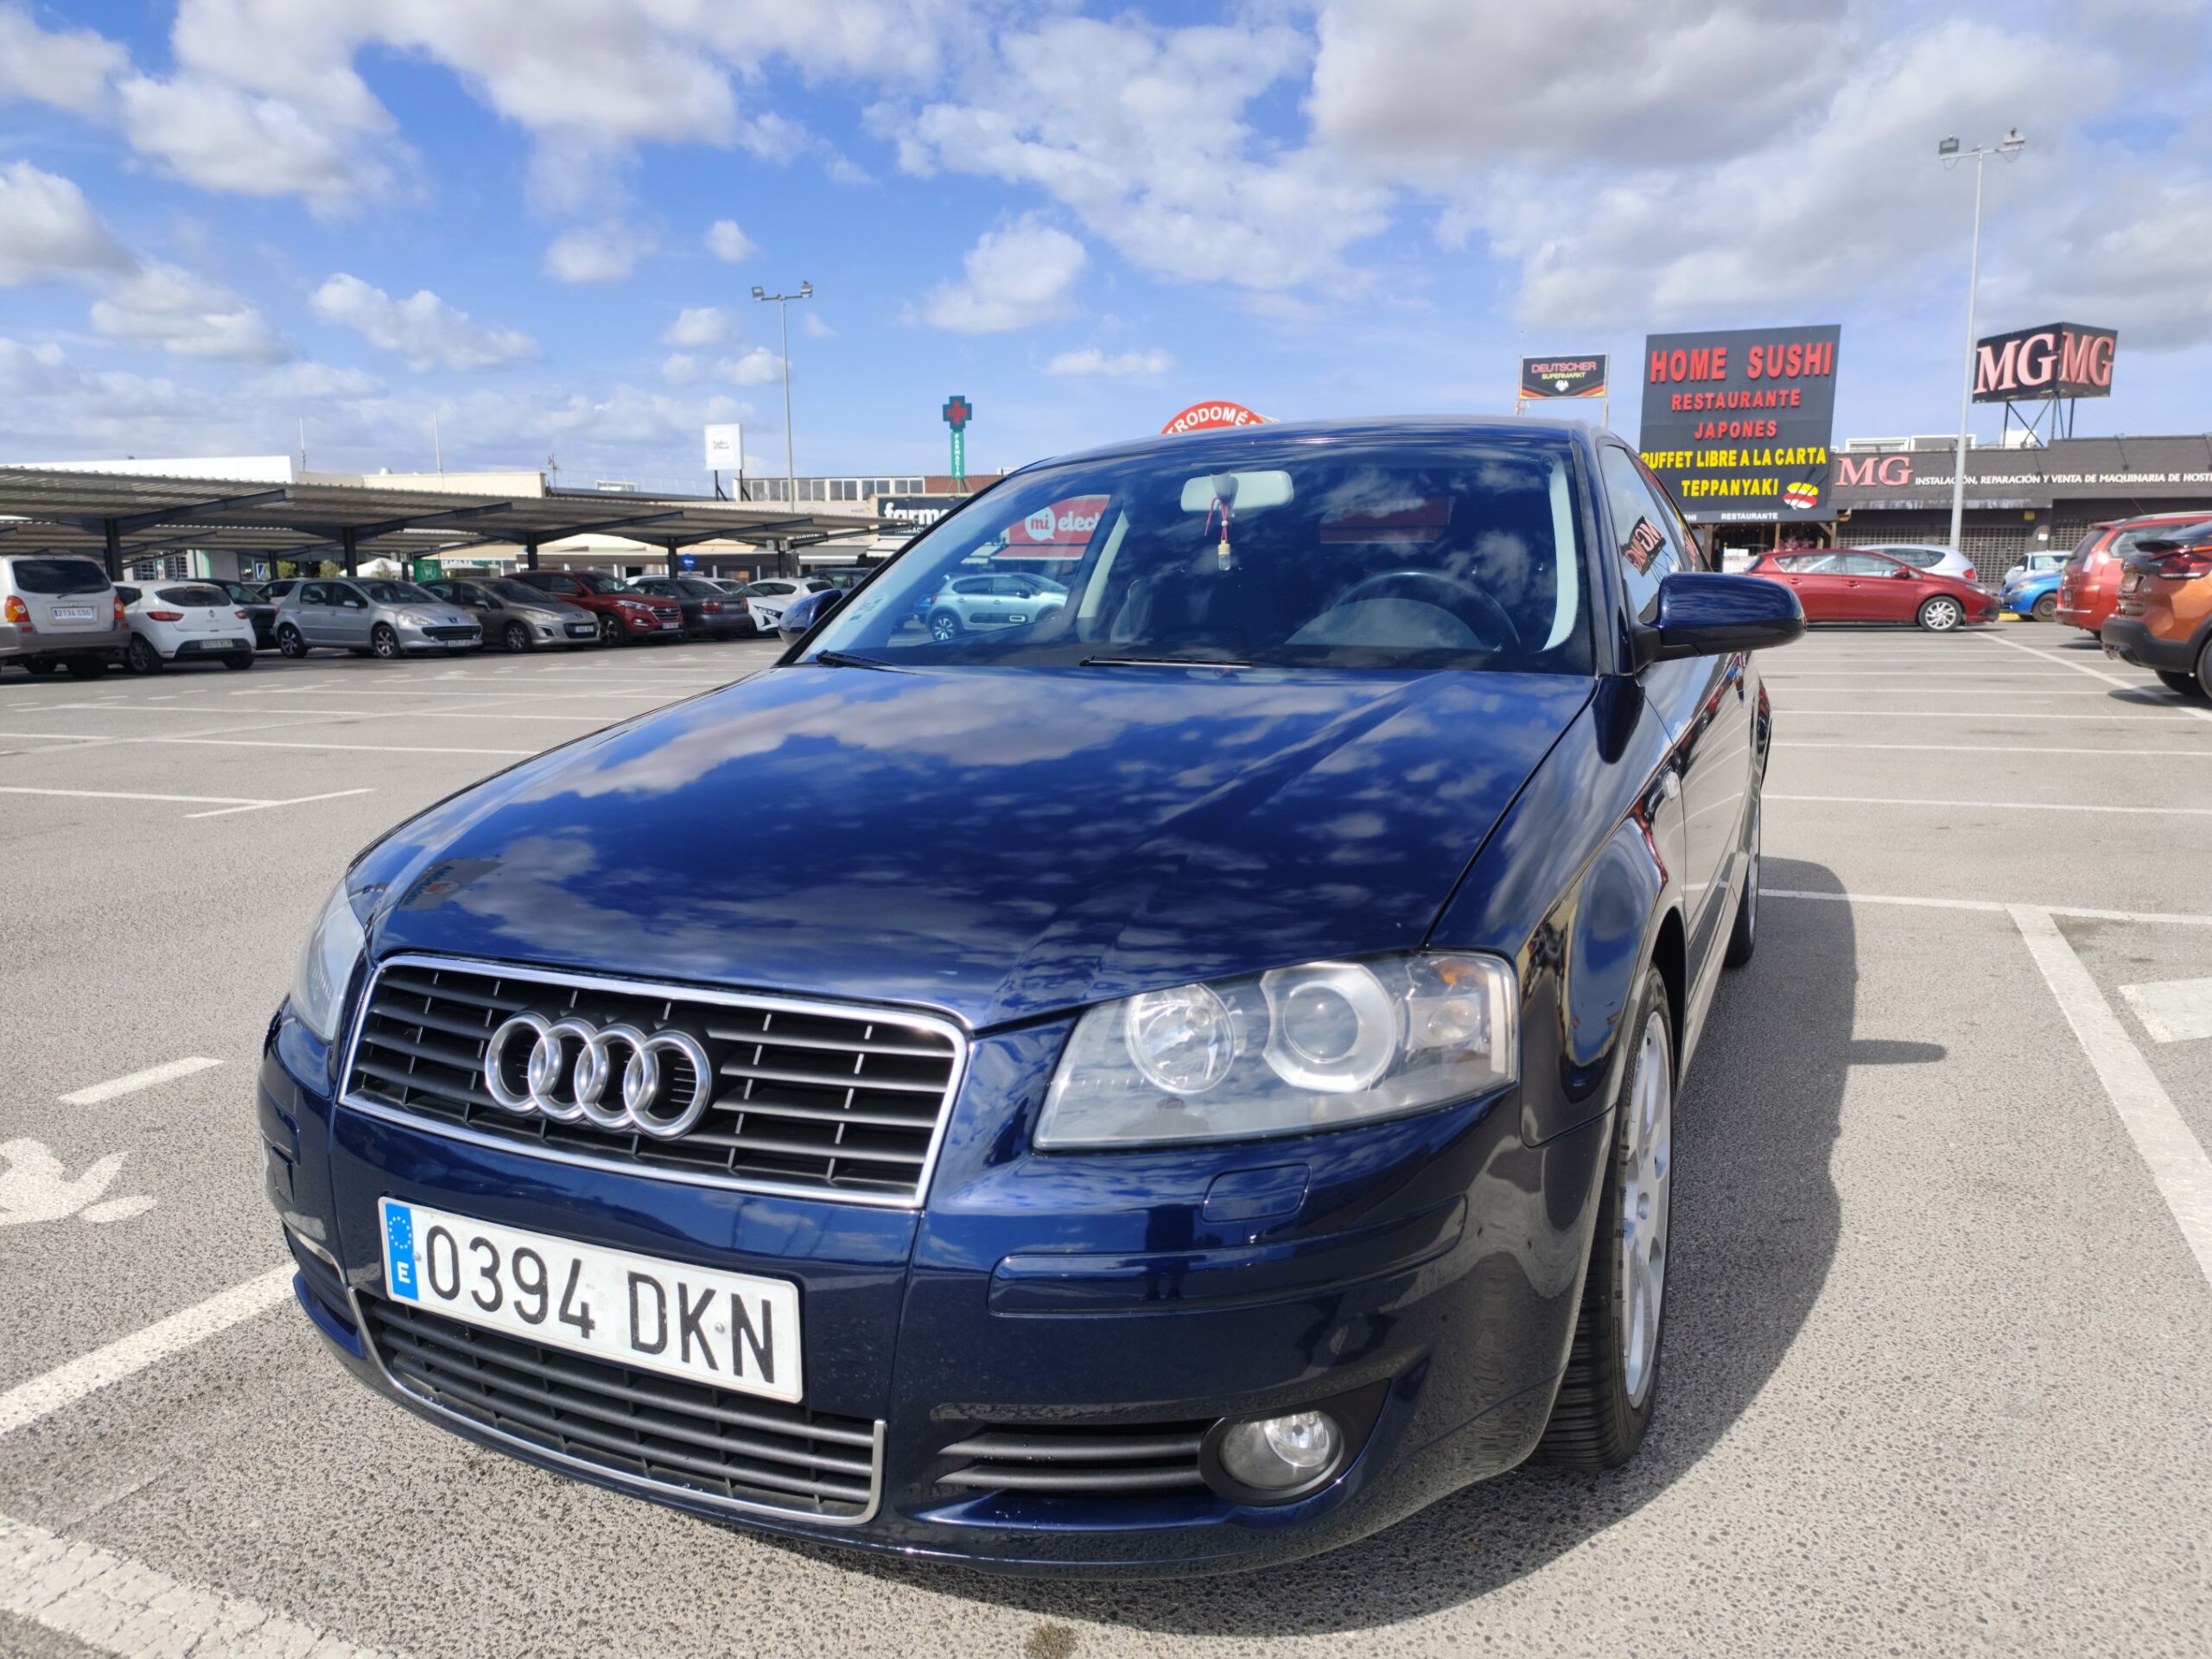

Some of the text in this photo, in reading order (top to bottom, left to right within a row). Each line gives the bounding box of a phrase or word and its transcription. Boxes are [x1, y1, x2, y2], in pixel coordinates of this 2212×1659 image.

[1531, 361, 1597, 373] DEUTSCHER
[1649, 342, 1833, 383] HOME SUSHI
[1974, 334, 2057, 394] MG
[2059, 331, 2114, 386] MG
[1541, 372, 1586, 380] SUPERMARKT
[1671, 389, 1801, 411] RESTAURANTE
[1694, 420, 1777, 440] JAPONES
[1696, 449, 1737, 468] LIBRE
[1739, 449, 1750, 467] A
[1753, 448, 1772, 467] LA
[1775, 447, 1827, 466] CARTA
[1835, 456, 1914, 486] MG
[1980, 474, 2040, 485] REPARACIÓN
[2043, 474, 2051, 483] Y
[2051, 474, 2082, 484] VENTA
[2084, 474, 2097, 483] DE
[2099, 474, 2165, 484] MAQUINARIA
[2168, 473, 2181, 482] DE
[1681, 479, 1779, 497] TEPPANYAKI
[1031, 513, 1052, 530] mi
[397, 1262, 411, 1285] E
[426, 1225, 776, 1384] 0394 DKN
